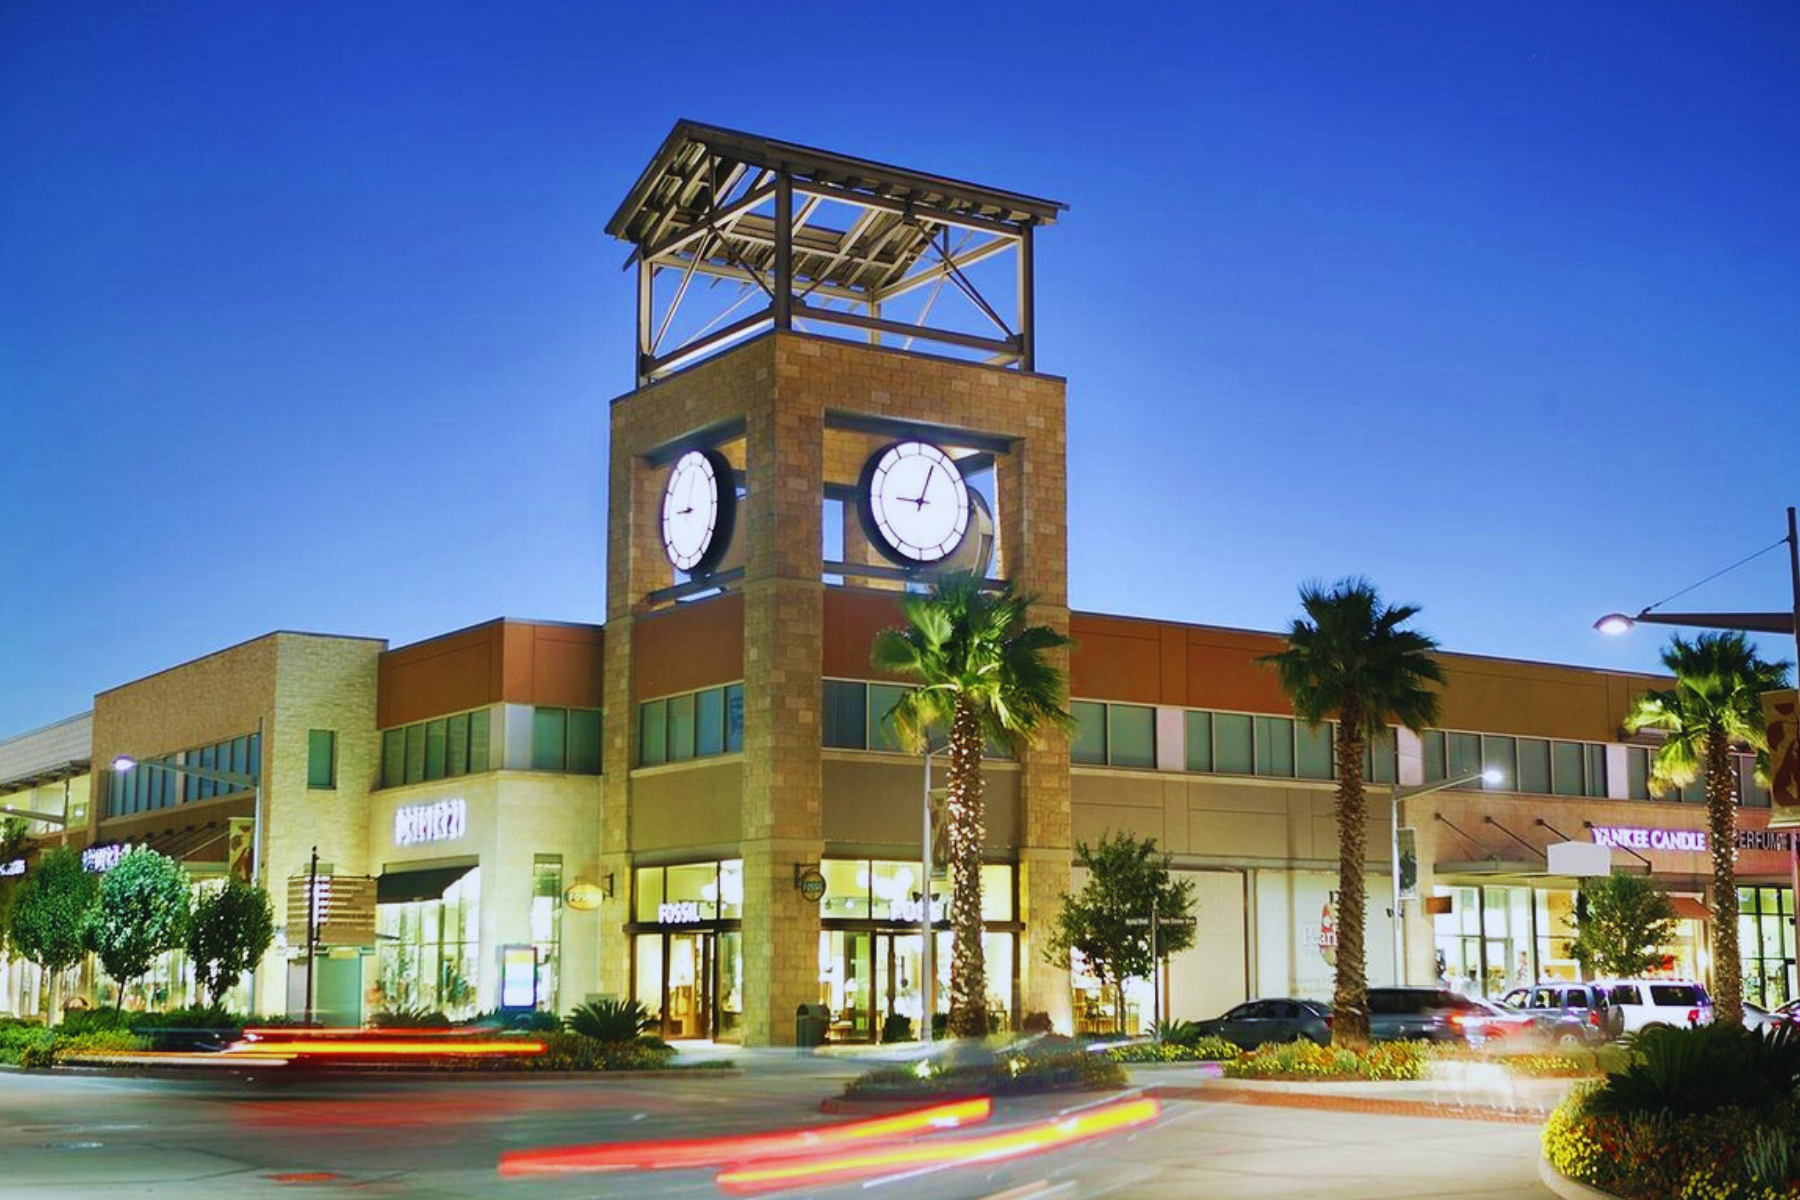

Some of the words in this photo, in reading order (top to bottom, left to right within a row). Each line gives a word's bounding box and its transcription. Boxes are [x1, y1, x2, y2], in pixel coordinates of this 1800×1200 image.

[1592, 827, 1650, 848] YANKEE
[1651, 830, 1706, 851] CANDLE
[658, 901, 700, 923] FOSSIL
